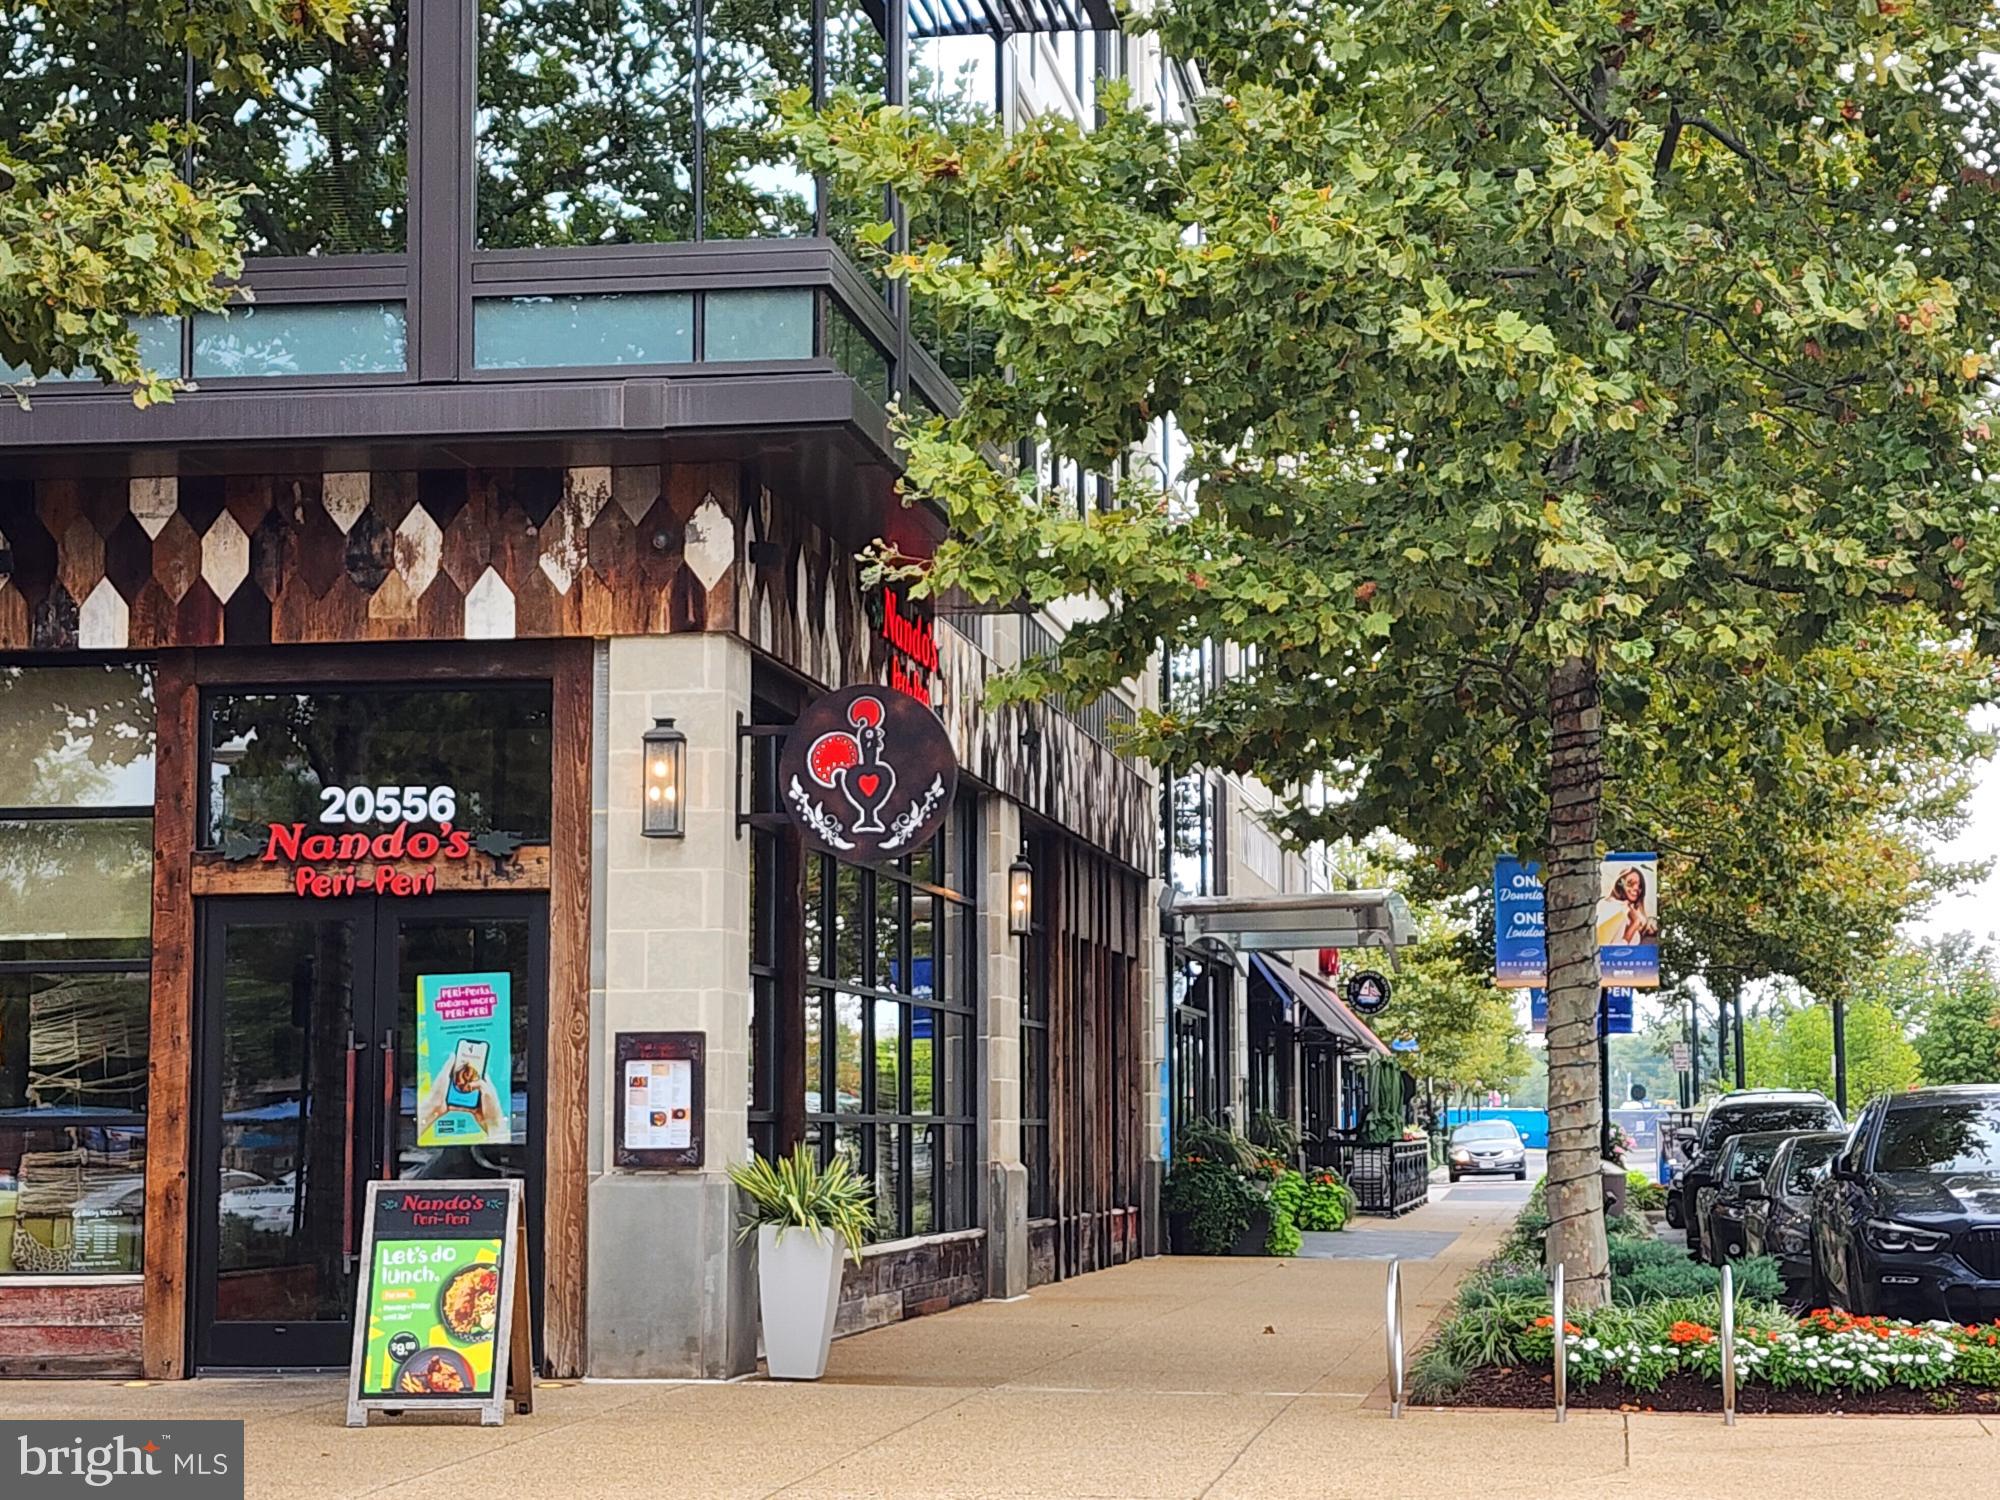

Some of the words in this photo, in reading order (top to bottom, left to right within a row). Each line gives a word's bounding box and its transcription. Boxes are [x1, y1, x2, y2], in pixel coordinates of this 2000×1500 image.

[882, 586, 938, 673] Nando's
[319, 785, 456, 823] 20556
[261, 820, 471, 862] Nando's
[296, 865, 436, 898] Peri-Peri
[1499, 887, 1545, 902] Downto
[1513, 911, 1545, 925] ONE
[1505, 924, 1546, 940] Loudou
[1607, 986, 1631, 998] PEN
[401, 1194, 484, 1211] Nando's
[413, 1212, 470, 1225] Peri-Peri
[382, 1247, 428, 1265] Let's
[431, 1244, 457, 1263] do
[382, 1265, 440, 1285] lunch.
